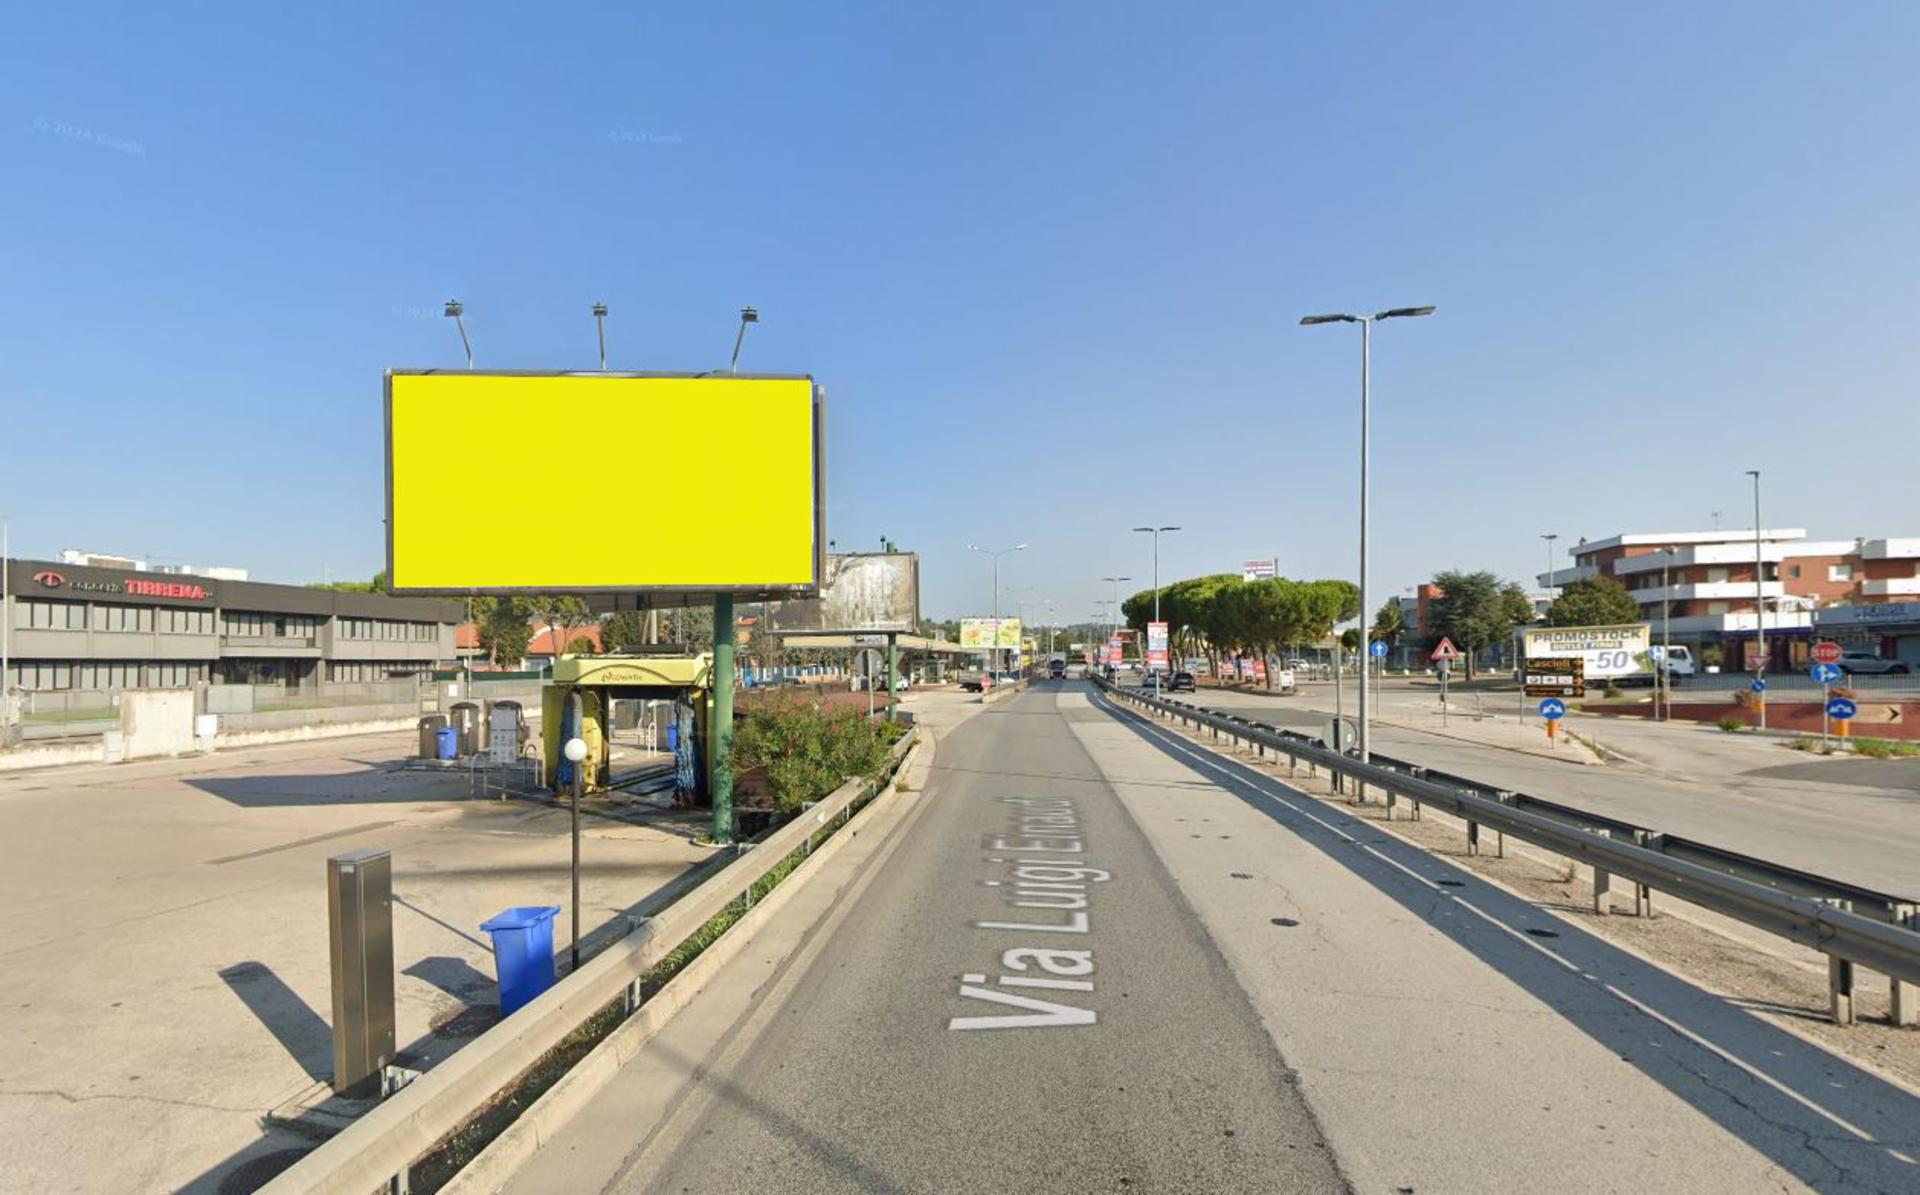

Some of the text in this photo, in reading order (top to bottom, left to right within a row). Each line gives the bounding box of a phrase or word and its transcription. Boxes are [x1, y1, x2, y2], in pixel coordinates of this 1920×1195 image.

[125, 579, 204, 600] TIRRENA
[1533, 629, 1642, 643] PROMOSTOCK
[1813, 647, 1839, 657] STOP
